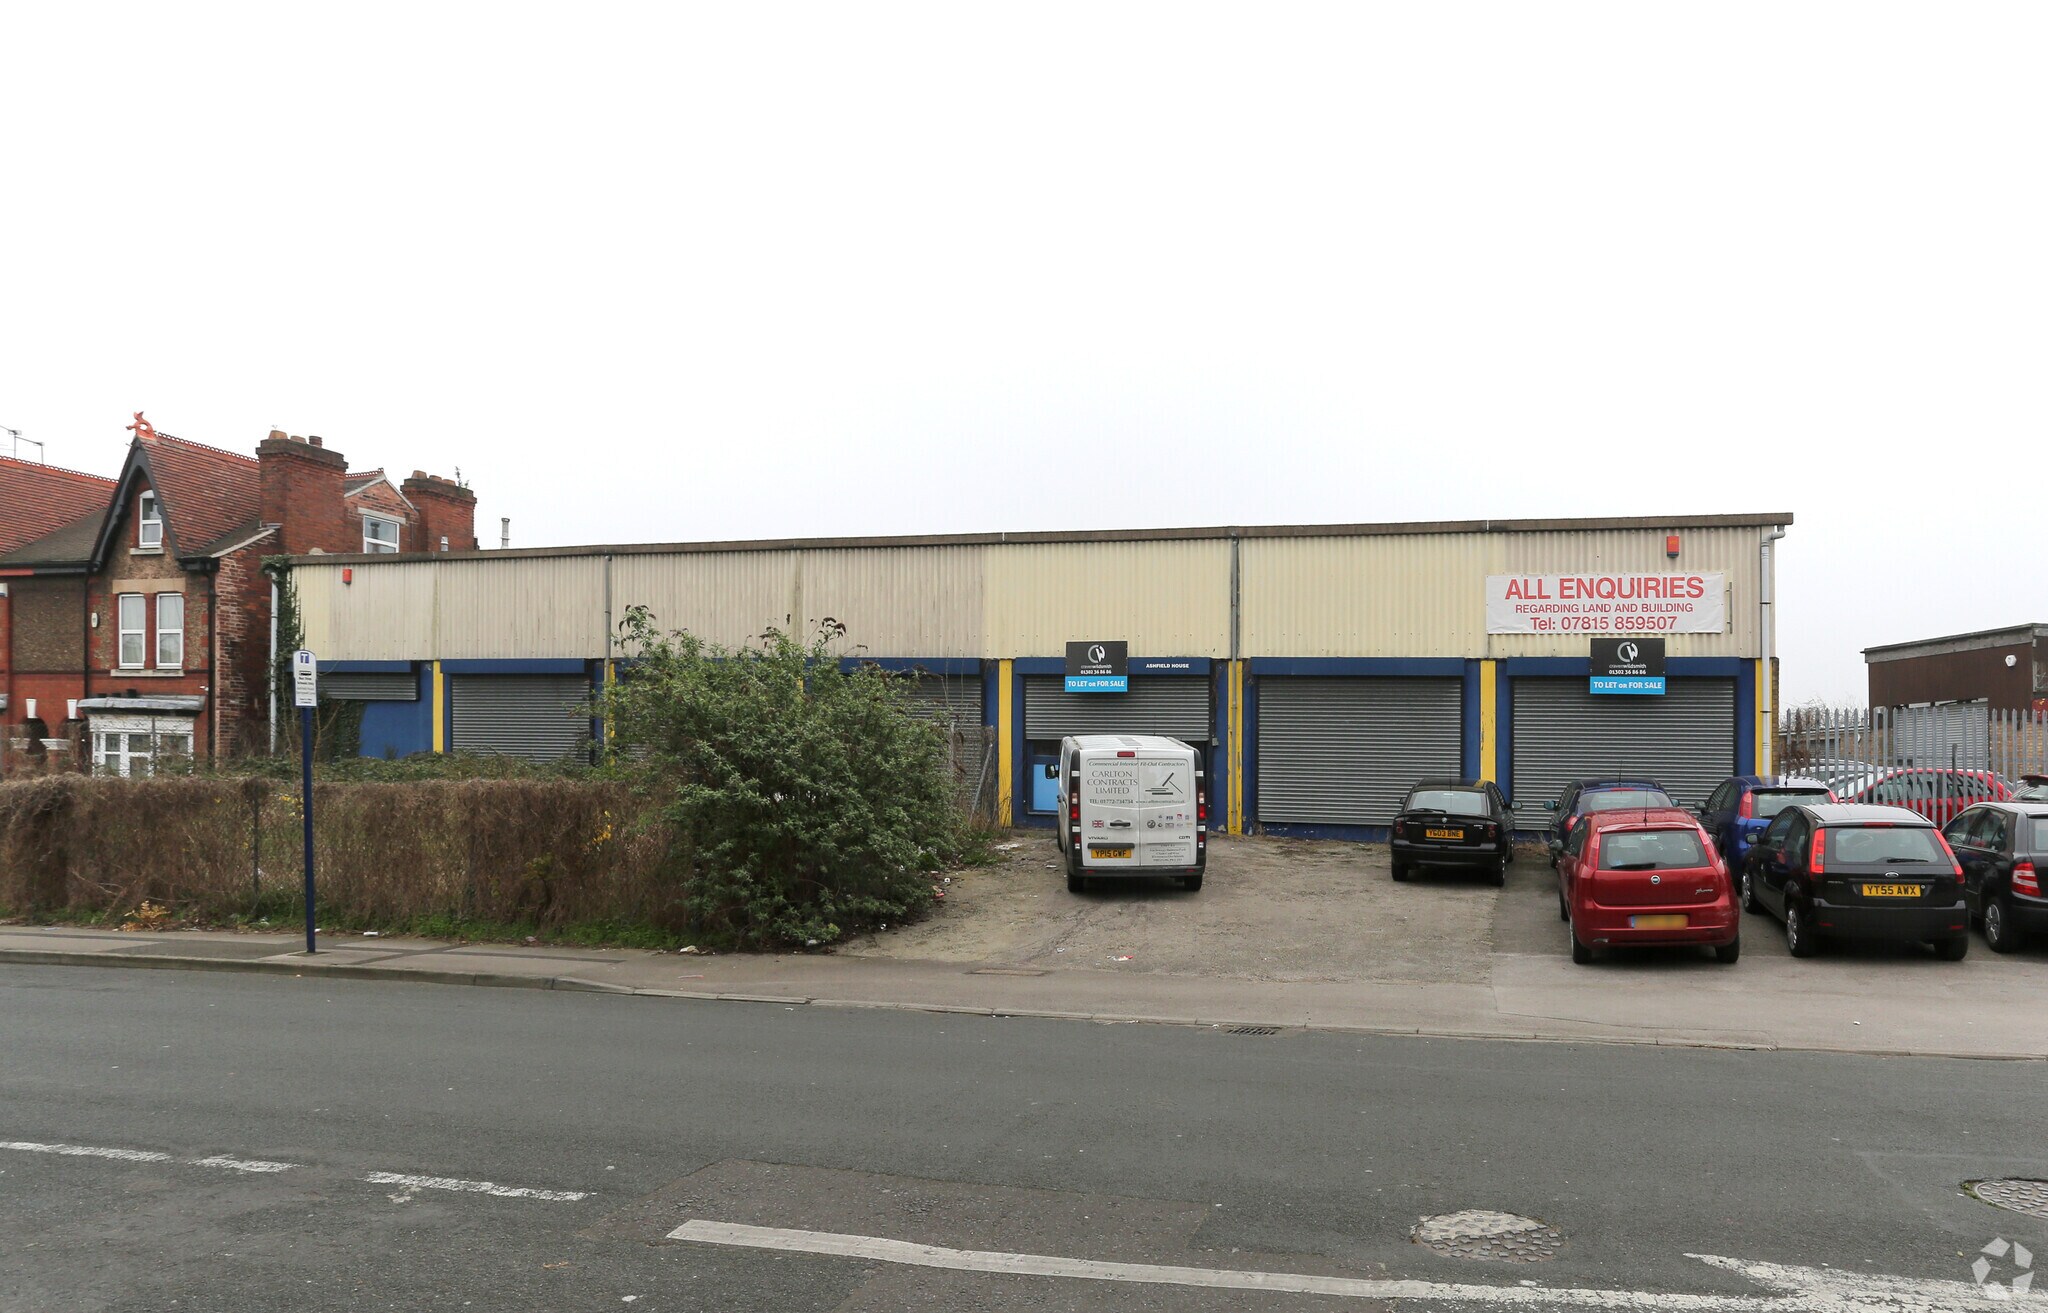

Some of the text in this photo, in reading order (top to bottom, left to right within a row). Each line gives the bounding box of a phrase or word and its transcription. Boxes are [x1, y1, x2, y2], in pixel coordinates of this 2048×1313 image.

[1505, 576, 1704, 600] ALL ENQUIRIES
[1516, 602, 1693, 614] REGARDING LAND AND BUILDING
[1530, 616, 1678, 630] Tel: 07815 859507
[1867, 886, 1916, 894] YT55 AWX
